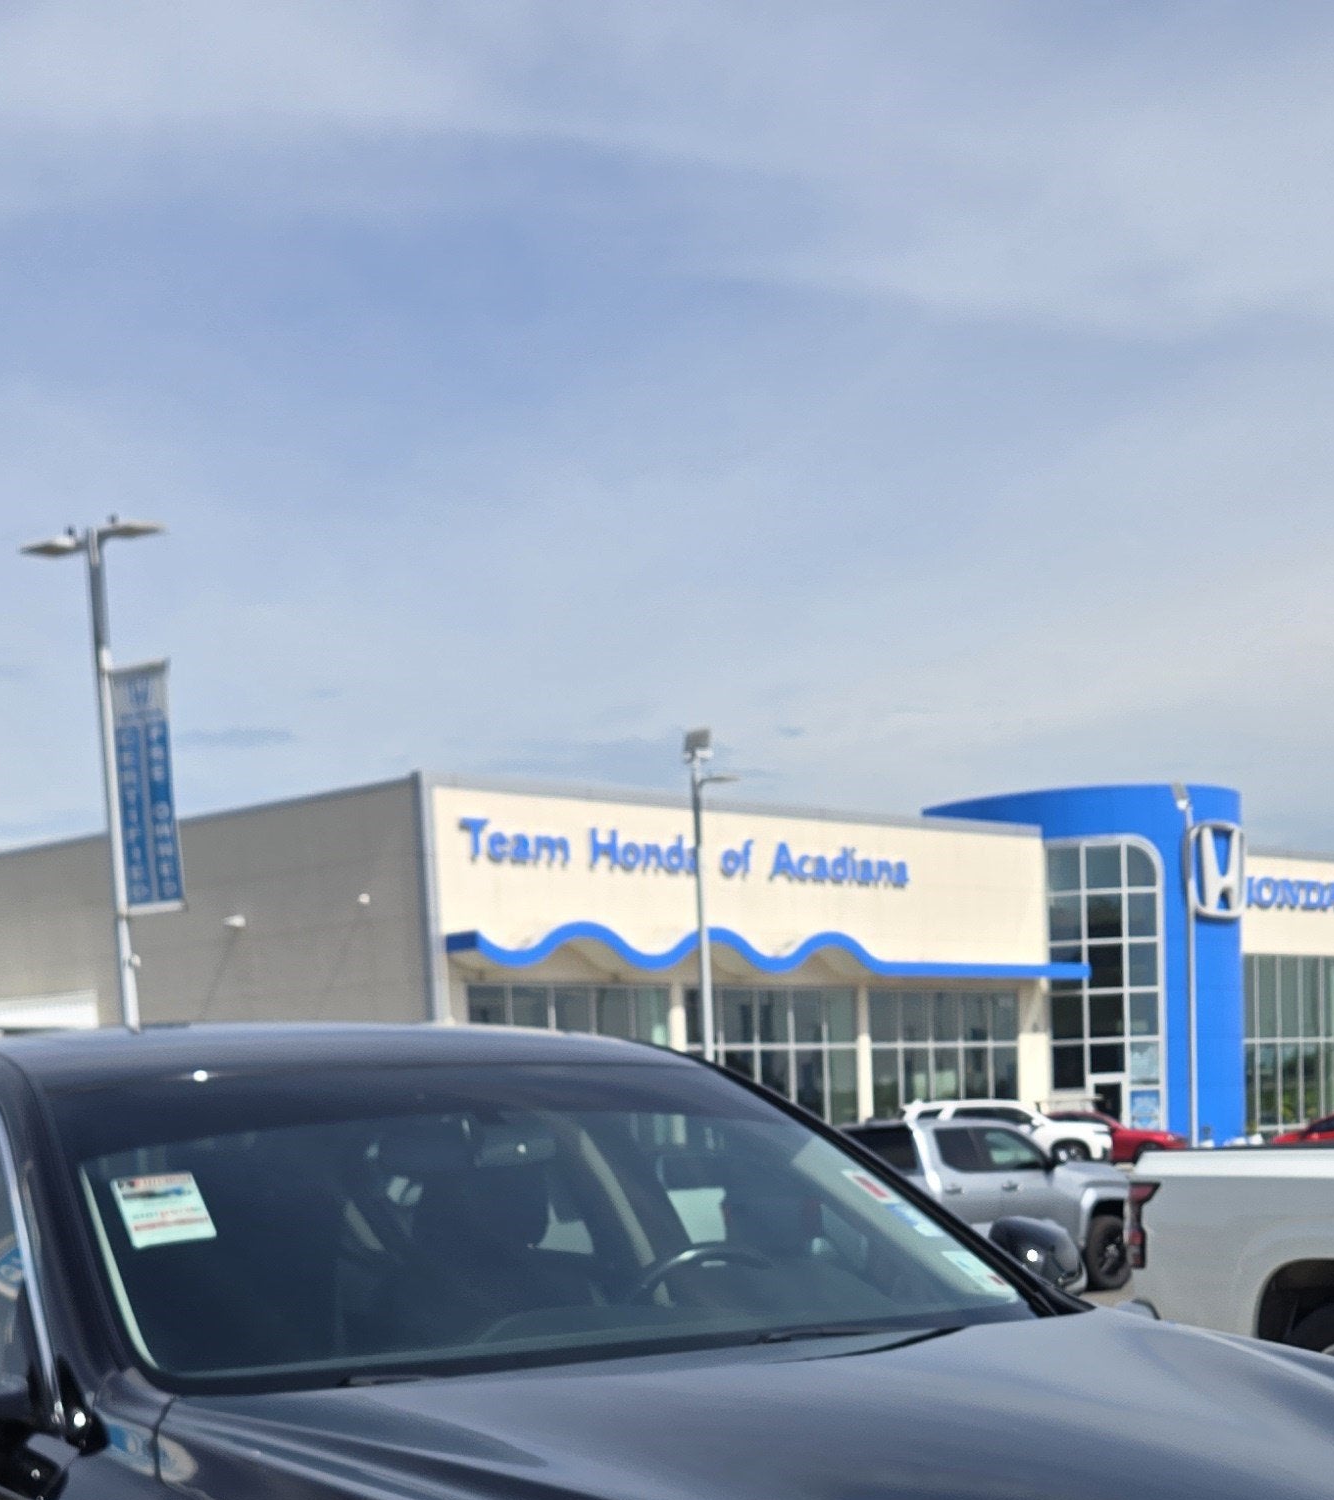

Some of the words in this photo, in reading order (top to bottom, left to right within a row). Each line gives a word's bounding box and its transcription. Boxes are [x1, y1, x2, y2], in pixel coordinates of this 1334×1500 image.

[460, 817, 571, 866] Team
[720, 838, 755, 879] of
[769, 841, 910, 889] Acadiana
